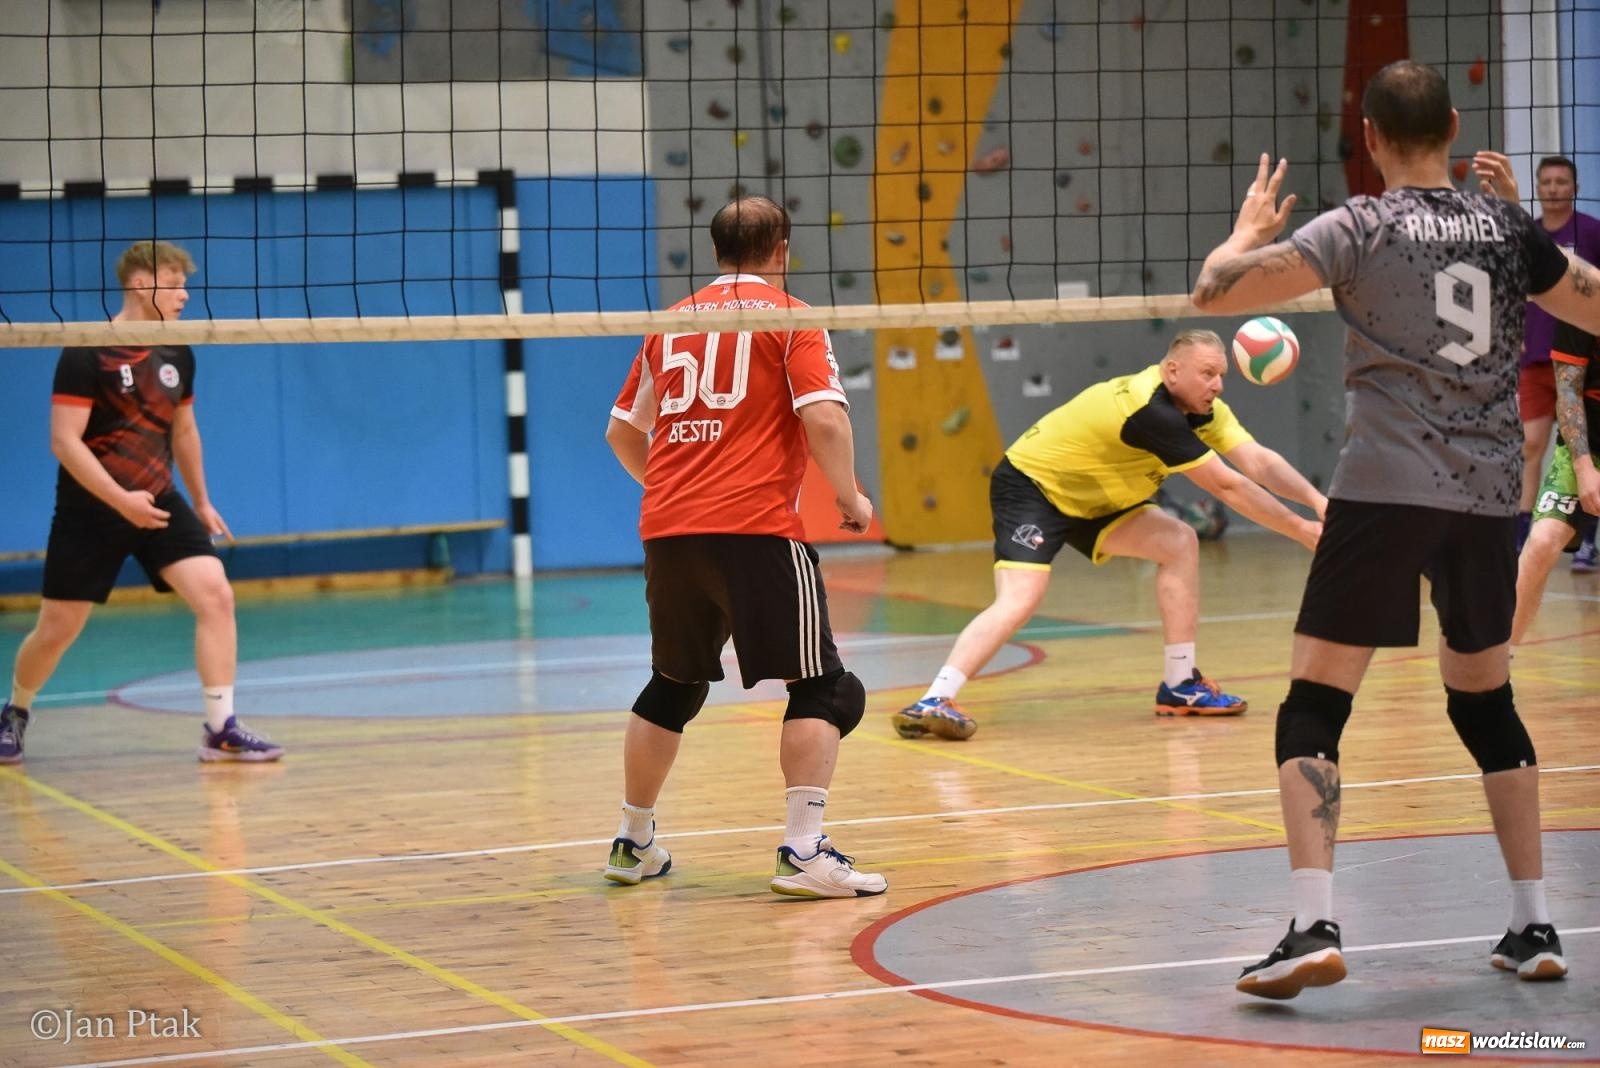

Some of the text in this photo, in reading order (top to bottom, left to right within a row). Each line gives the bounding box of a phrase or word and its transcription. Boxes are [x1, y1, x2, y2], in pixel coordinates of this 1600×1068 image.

[1434, 261, 1491, 366] 9
[120, 364, 134, 387] 9
[660, 331, 752, 416] 50
[668, 419, 723, 443] BESTA
[1537, 490, 1580, 515] 65
